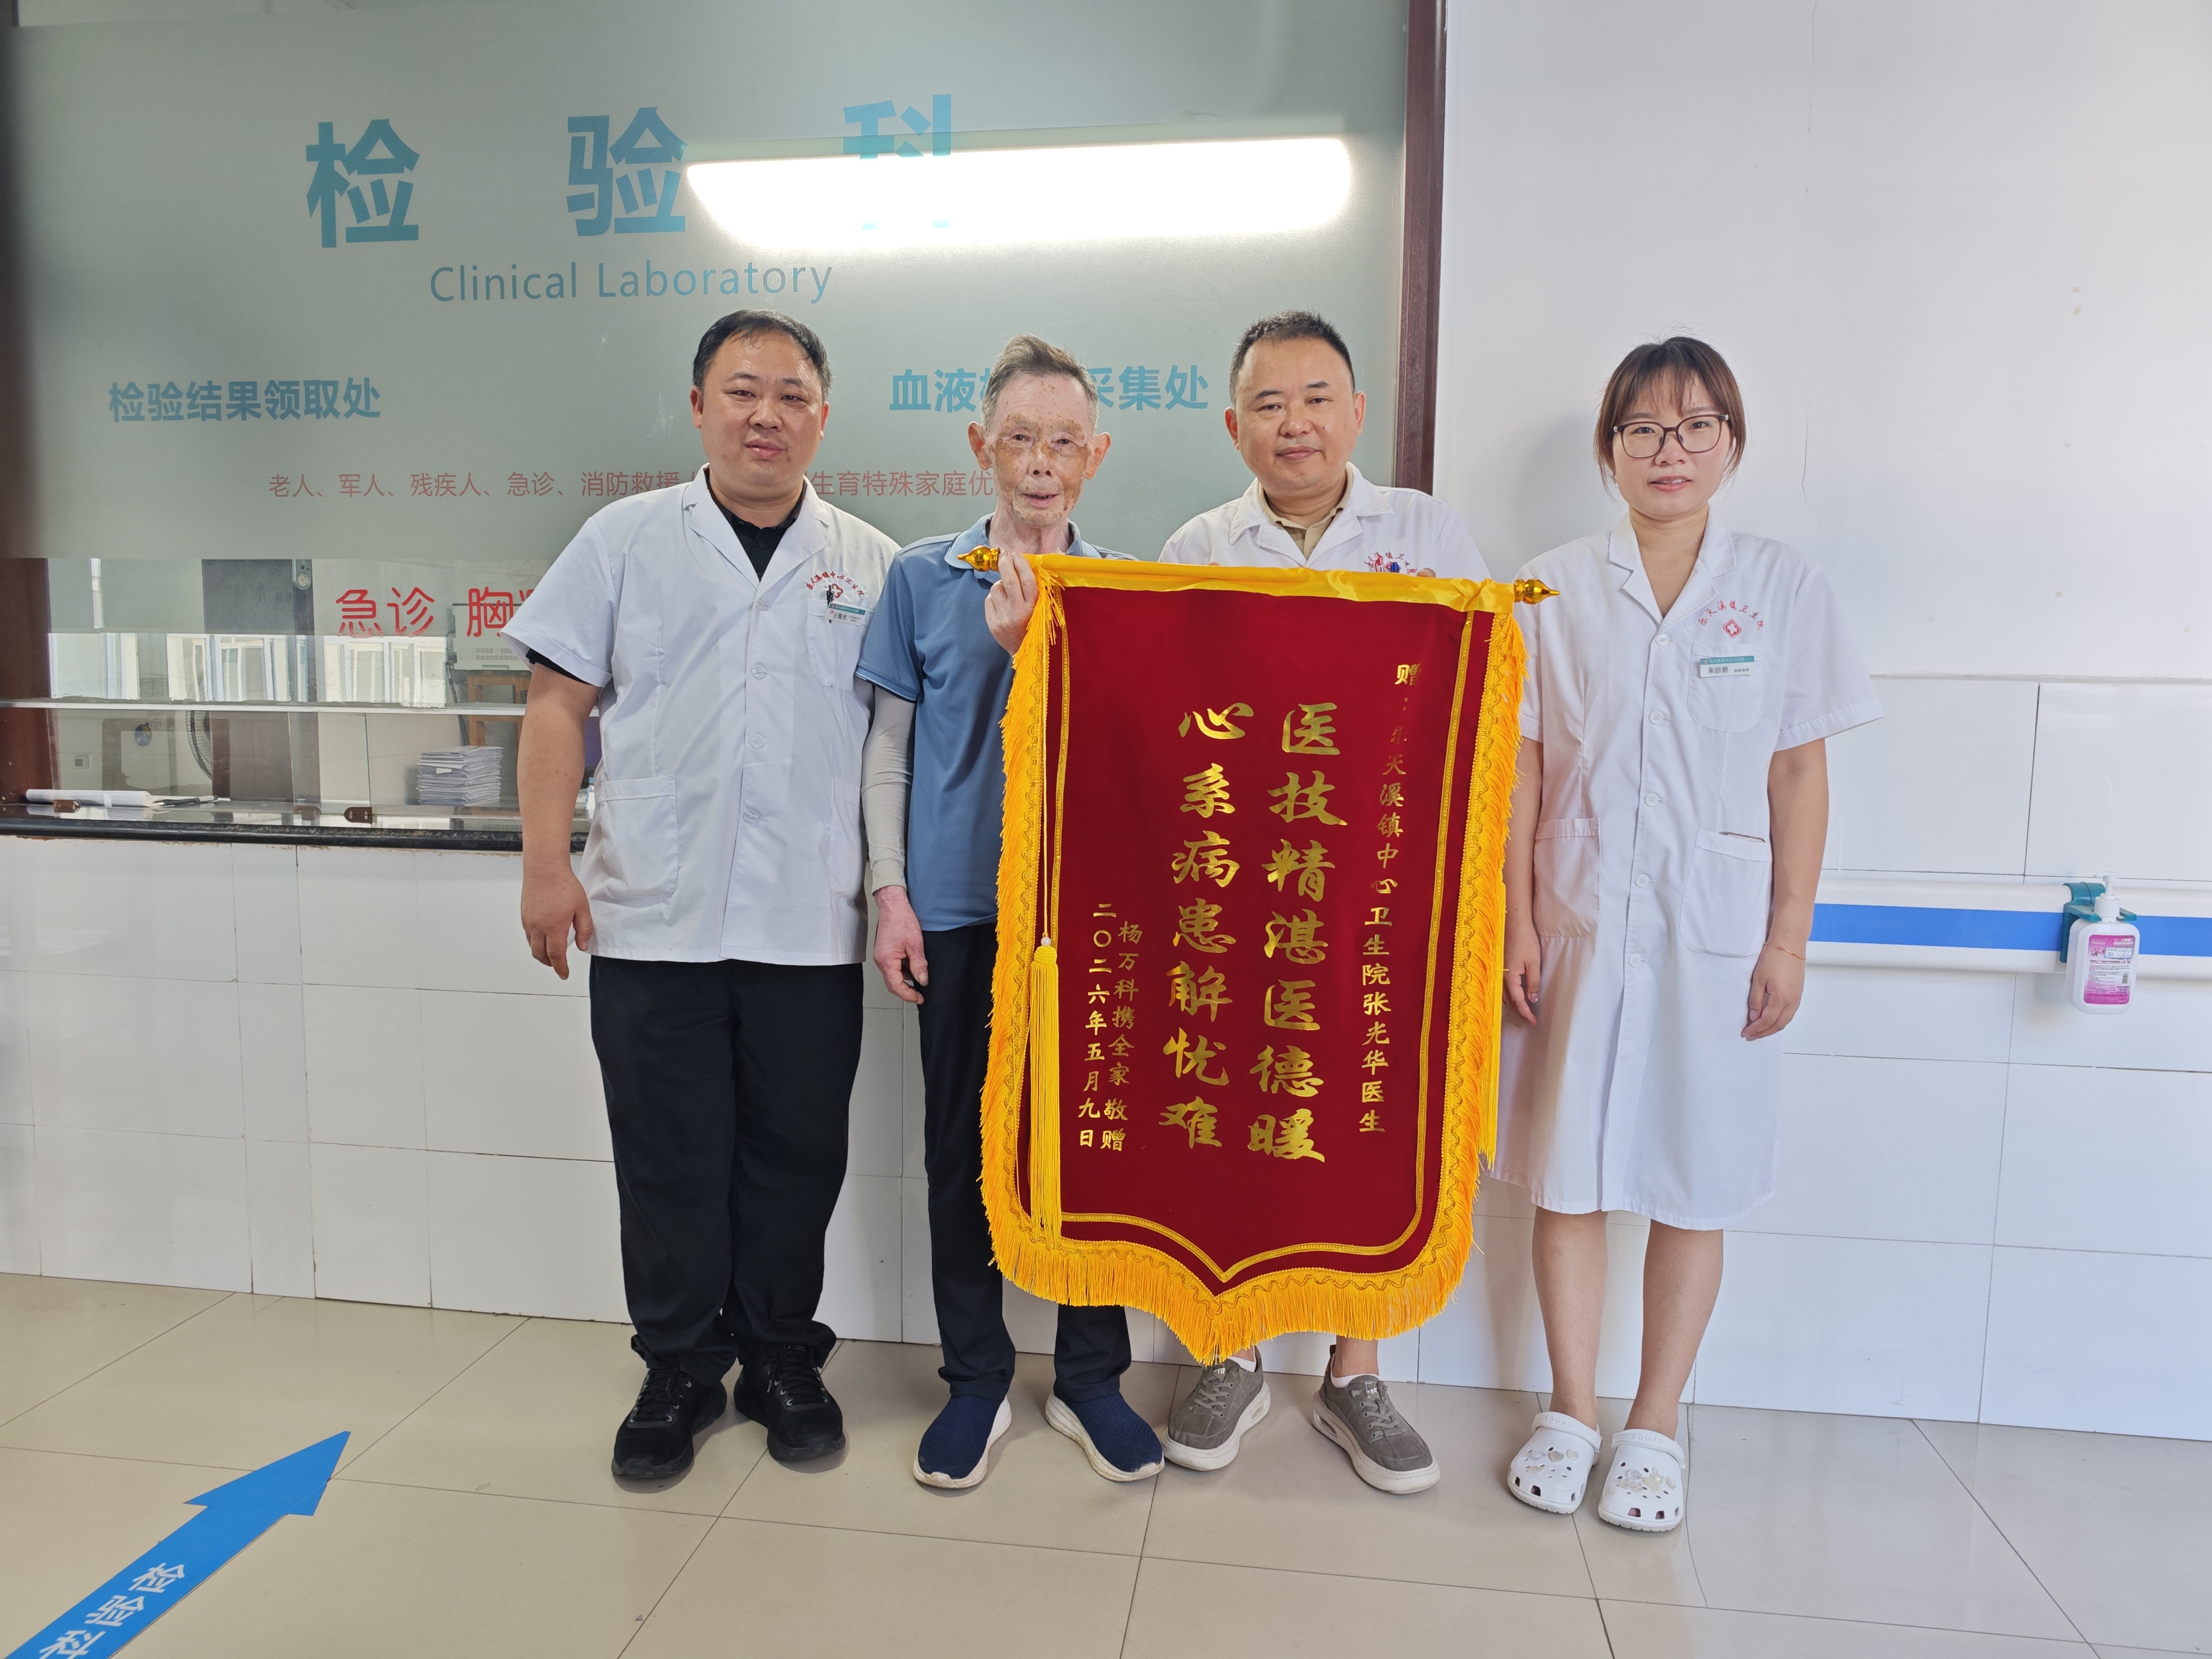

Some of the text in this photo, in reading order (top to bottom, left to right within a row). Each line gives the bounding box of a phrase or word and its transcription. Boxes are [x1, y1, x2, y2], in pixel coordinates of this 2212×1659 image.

[432, 260, 832, 305] Clinical Laboratory
[109, 376, 381, 423] 检验结果领取处
[335, 586, 535, 638] 急诊 胸
[1158, 703, 1255, 1149] 心系病患解忧难
[1247, 702, 1348, 1163] 医技精湛医德暖
[1100, 921, 1143, 1152] 杨万科携全家敬赠
[1545, 1415, 1573, 1428] crocs
[1631, 1433, 1663, 1445] crocs
[39, 1562, 185, 1659] 检验科
